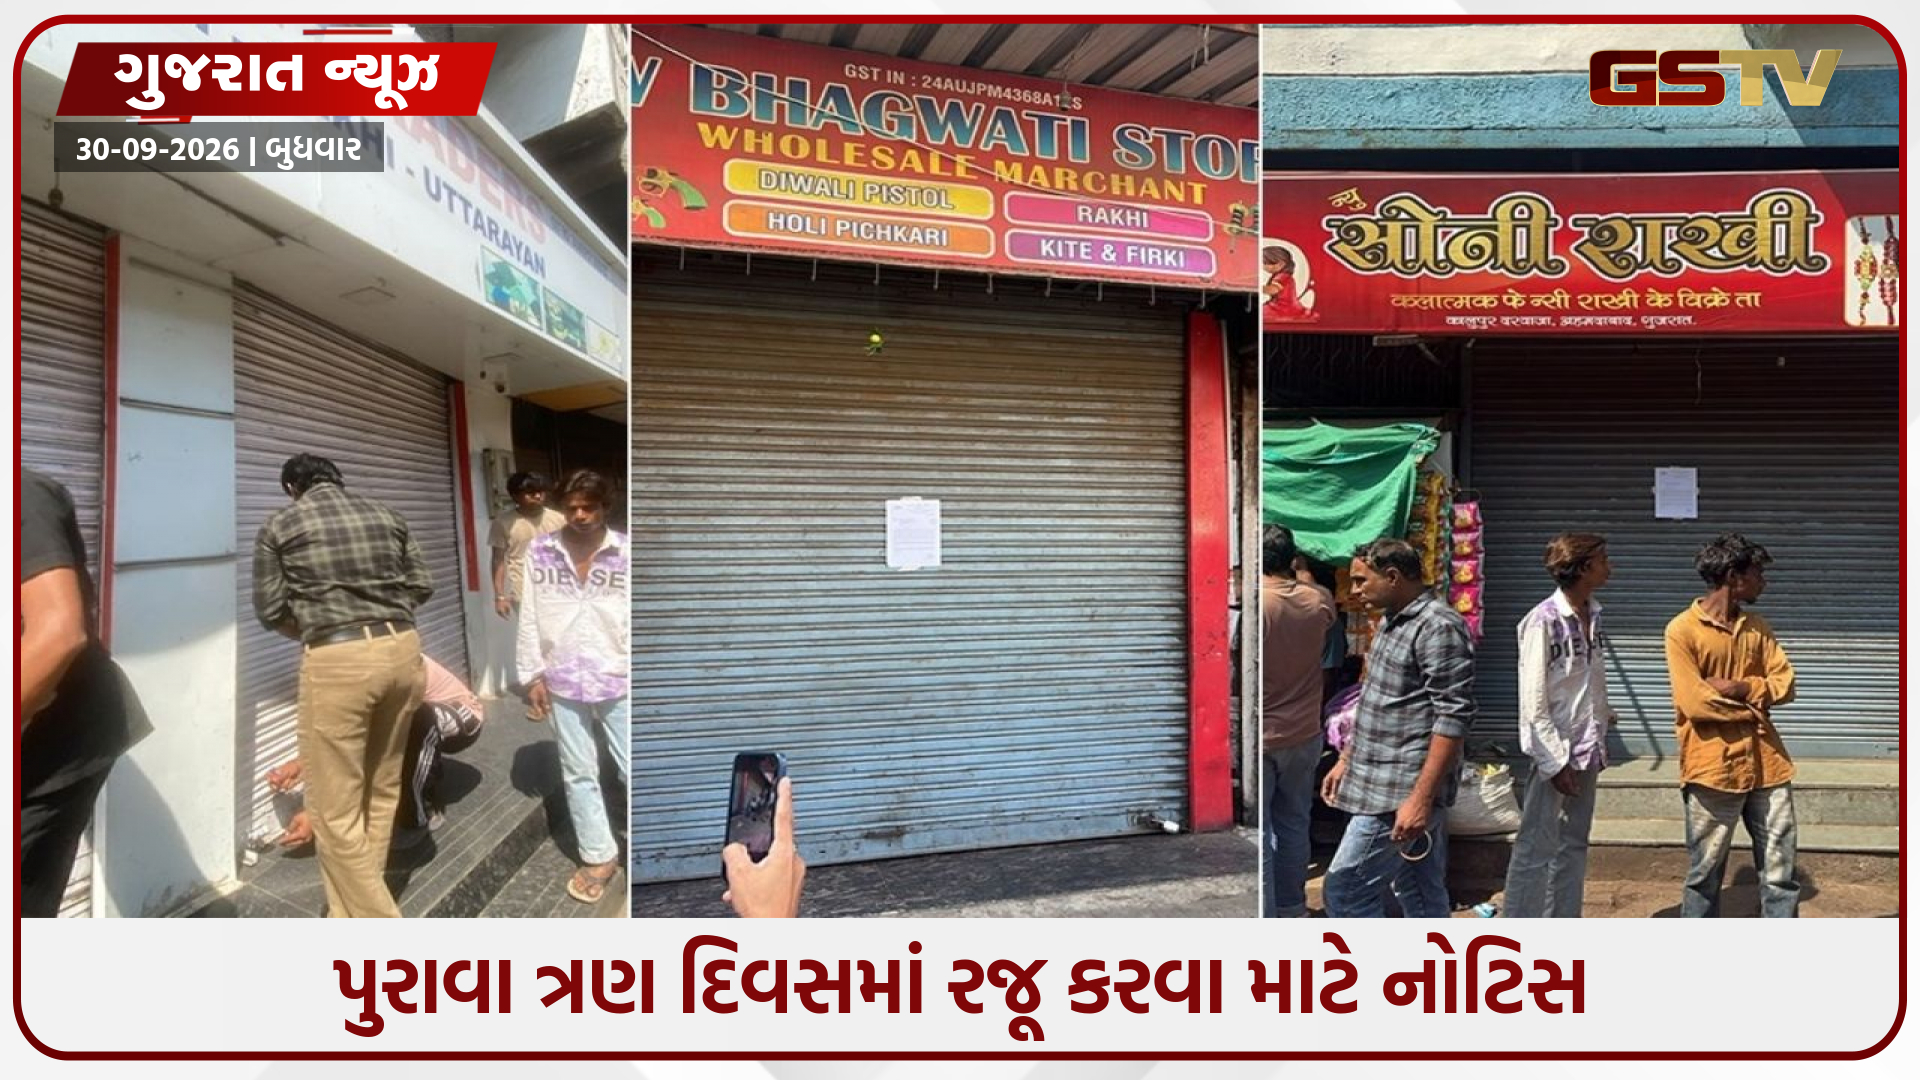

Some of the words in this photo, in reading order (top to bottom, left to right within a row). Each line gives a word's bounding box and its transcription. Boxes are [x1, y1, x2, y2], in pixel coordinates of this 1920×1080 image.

[844, 64, 882, 81] GST
[886, 70, 905, 85] IN
[921, 75, 1083, 111] 24AUJPM4368A1S
[689, 61, 1090, 164] BHAGWATI
[696, 122, 978, 179] WHOLESALE
[994, 160, 1208, 205] MARCHANT
[759, 168, 855, 200] DIWALI
[863, 182, 956, 210] PISTOL
[422, 165, 548, 280] UTTARAYAN
[767, 211, 827, 235] HOLI
[835, 215, 949, 247] PICHKARI
[1076, 203, 1150, 228] RAKHI
[1325, 193, 1569, 277] सोनी
[1573, 188, 1830, 281] राखी
[1039, 239, 1093, 260] KITE
[1101, 243, 1117, 263] &
[1126, 245, 1186, 269] FIRKI
[1391, 291, 1499, 311] कलात्मक
[1577, 287, 1642, 312] राखी
[1645, 287, 1675, 309] के
